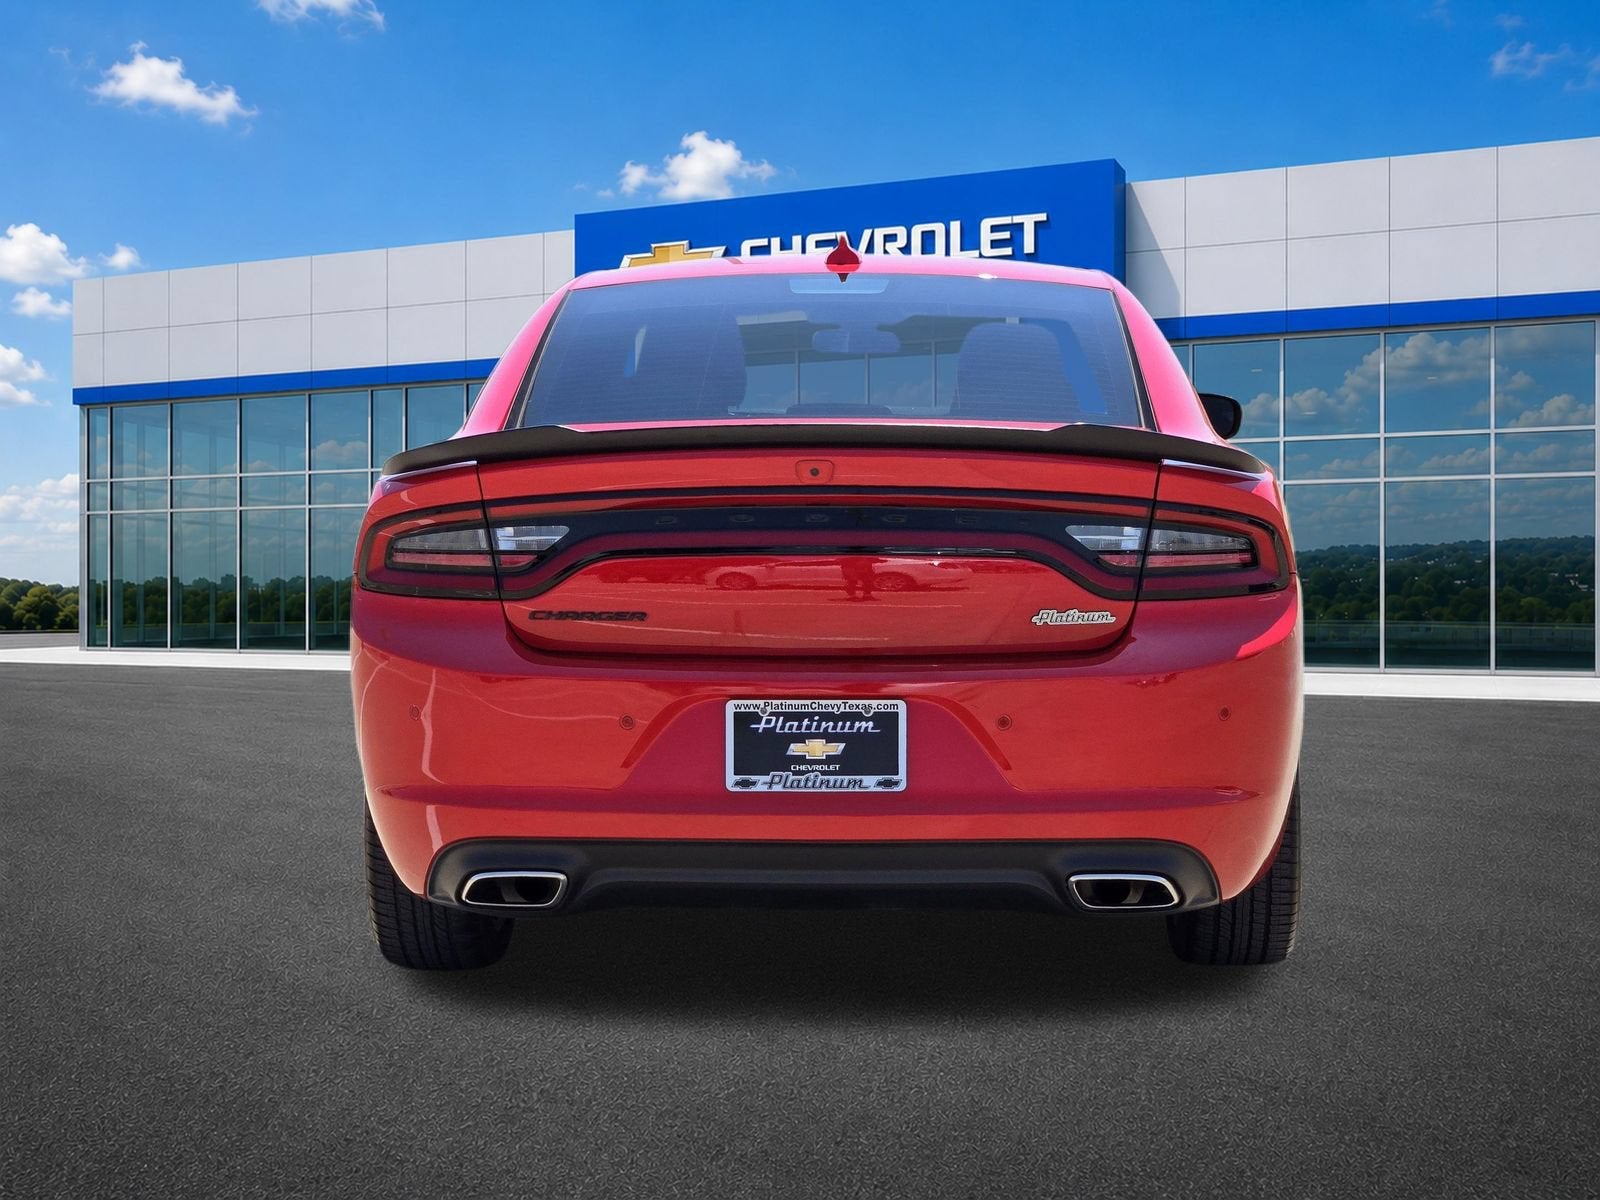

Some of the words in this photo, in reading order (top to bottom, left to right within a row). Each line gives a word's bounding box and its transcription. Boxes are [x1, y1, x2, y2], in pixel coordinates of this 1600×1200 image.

[528, 610, 648, 621] CHARGER
[1032, 609, 1116, 625] Platinum
[733, 701, 899, 714] www.PlatinumChevyTexas.com
[750, 716, 880, 733] Platinum
[761, 772, 871, 791] Platinum
